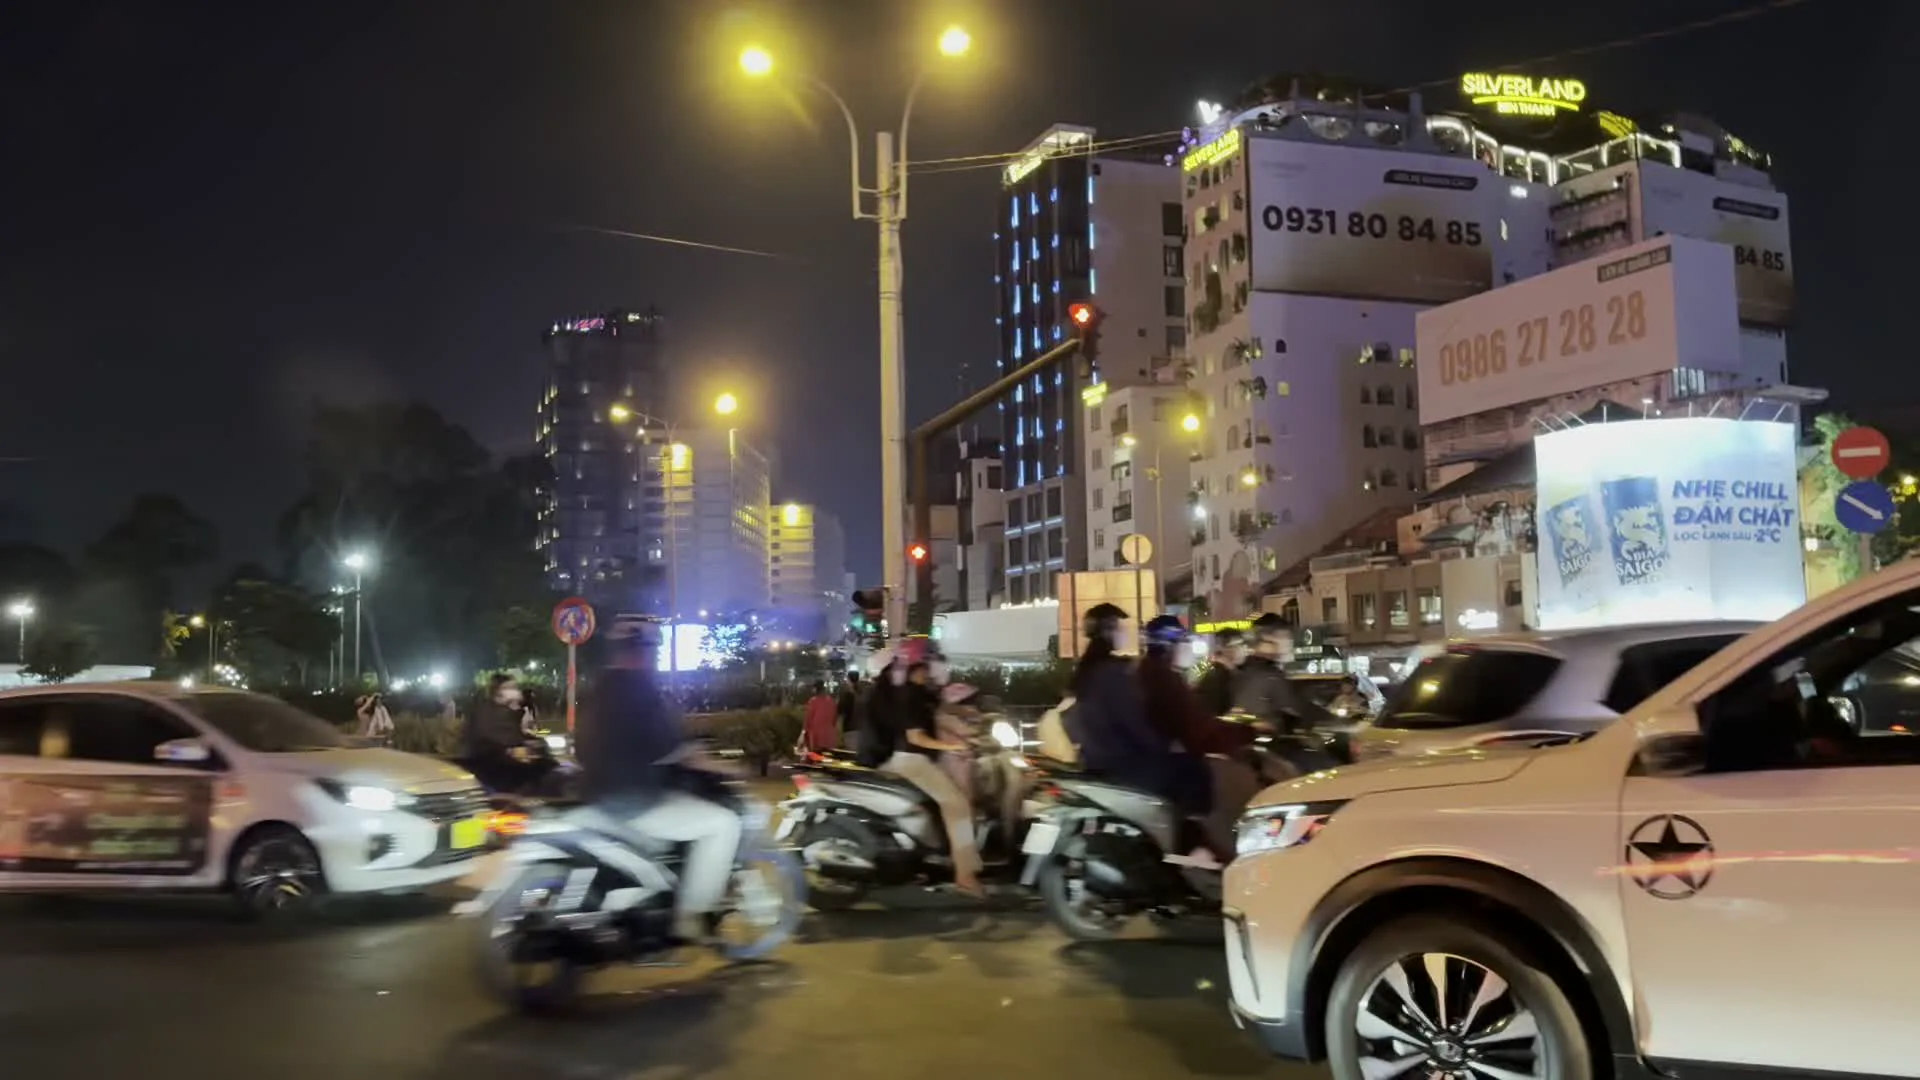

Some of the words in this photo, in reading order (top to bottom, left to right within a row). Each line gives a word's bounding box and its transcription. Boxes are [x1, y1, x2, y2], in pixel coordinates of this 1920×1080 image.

[1463, 73, 1586, 101] SILVERLAND
[1262, 205, 1337, 235] 0931
[1347, 212, 1387, 239] 80
[1398, 216, 1436, 243] 84
[1446, 220, 1482, 246] 85
[1763, 248, 1785, 271] 85
[1439, 328, 1507, 386] 0986
[1517, 317, 1549, 367] 27
[1560, 304, 1596, 357] 28
[1607, 290, 1646, 345] 28
[1672, 479, 1726, 502] NHẸ
[1731, 480, 1788, 501] CHILL
